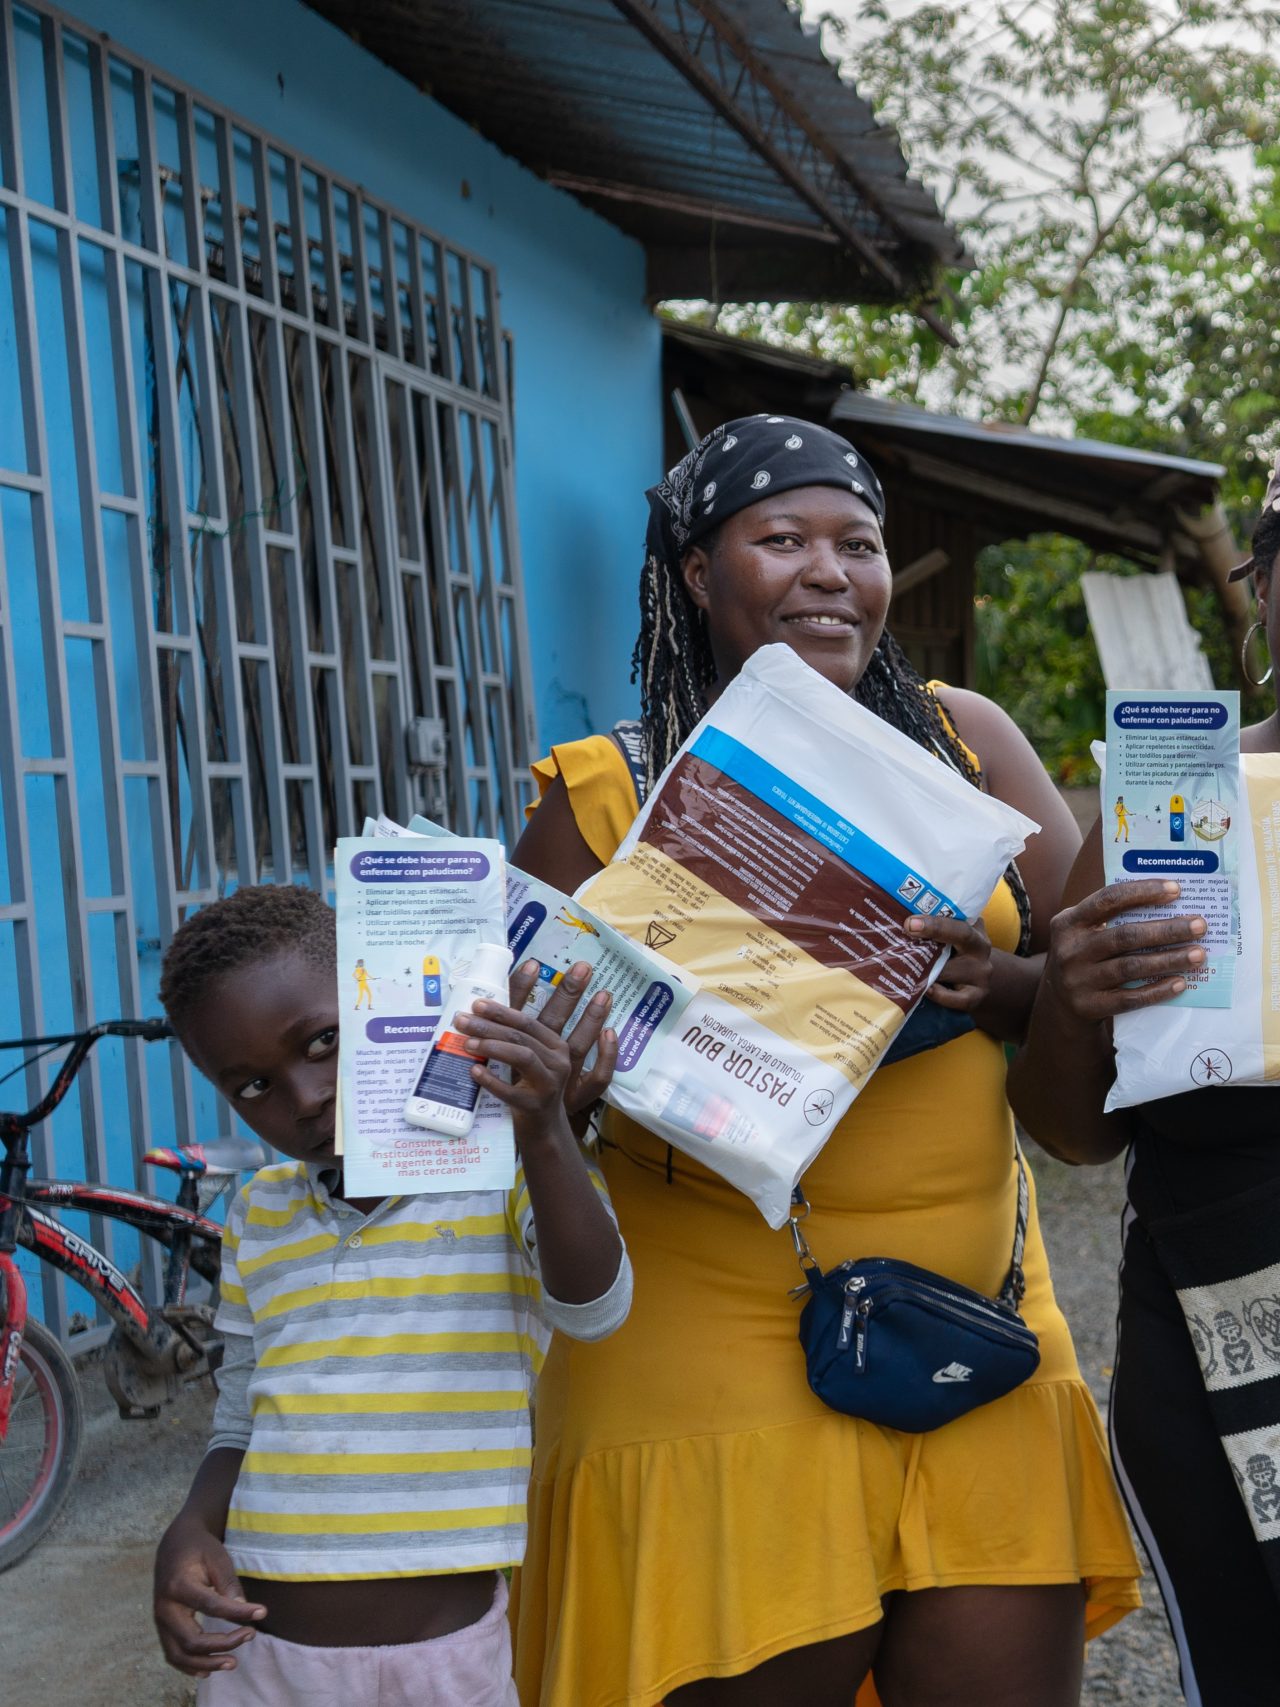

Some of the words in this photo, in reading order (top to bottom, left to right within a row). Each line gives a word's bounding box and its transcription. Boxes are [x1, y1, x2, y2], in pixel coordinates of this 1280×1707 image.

[1122, 706, 1139, 714] ¿Qué
[1171, 717, 1212, 725] paludismo?
[360, 856, 383, 865] ¿Qué
[396, 856, 418, 864] debe
[1138, 858, 1204, 866] Recomendación
[423, 868, 473, 877] paludismo?
[717, 980, 763, 1012] ESPECIFICACIONES
[638, 1004, 649, 1017] con
[615, 1016, 642, 1056] paludismo?
[636, 1020, 652, 1041] hacer
[698, 1012, 739, 1043] DURACIÓN
[627, 1039, 641, 1056] para
[679, 1022, 726, 1062] BDU
[735, 1035, 762, 1056] LARGA
[622, 1055, 632, 1067] no
[759, 1050, 772, 1063] DE
[720, 1048, 798, 1108] PASTOR
[769, 1056, 805, 1083] TOLDILLO
[435, 1149, 447, 1157] de
[450, 1147, 480, 1155] salud
[382, 1160, 392, 1168] al
[395, 1159, 433, 1169] agente
[452, 1156, 480, 1164] salud
[424, 1167, 466, 1175] cercano
[63, 1234, 125, 1292] DRIVE
[843, 1310, 853, 1328] NIKE
[944, 1361, 973, 1381] NIKE
